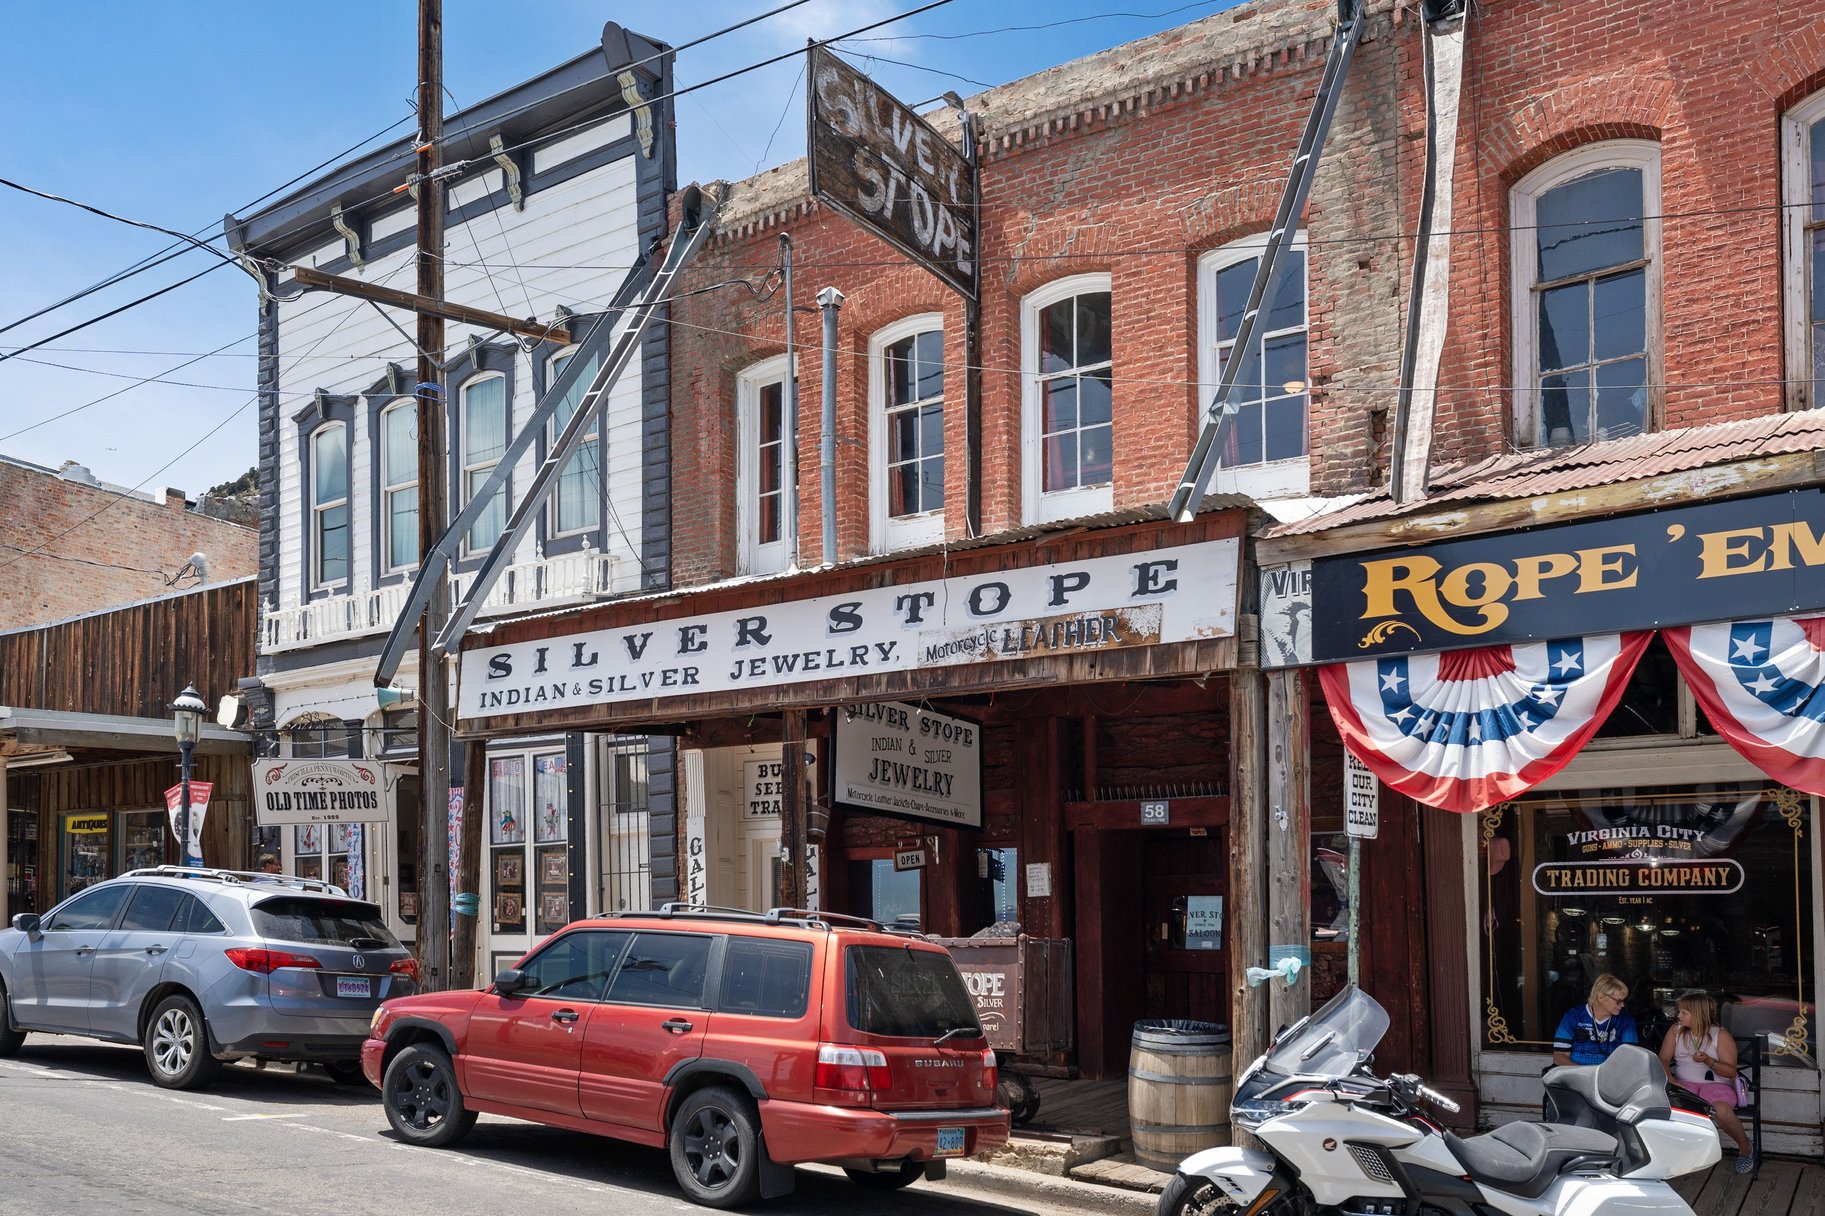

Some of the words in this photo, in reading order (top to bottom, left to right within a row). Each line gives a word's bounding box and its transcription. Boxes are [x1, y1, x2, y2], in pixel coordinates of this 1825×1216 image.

[853, 145, 973, 276] STOPE
[1359, 543, 1639, 636] ROPE
[488, 615, 772, 679] SILVER
[829, 558, 1180, 633] STOPE
[479, 683, 567, 708] INDIAN
[572, 682, 582, 696] &
[588, 665, 700, 695] SILVER
[729, 640, 900, 681] JEWELRY,
[921, 716, 973, 745] STOPE
[871, 737, 902, 752] INDIAN
[908, 738, 917, 756] &
[924, 749, 952, 764] SILVER
[758, 764, 783, 778] BU
[1348, 754, 1372, 772] KE
[868, 757, 954, 796] JEWELRY
[1352, 773, 1373, 790] OUR
[755, 782, 783, 796] SEL
[266, 791, 292, 811] OLD
[293, 791, 328, 811] TIME
[328, 790, 378, 810] PHOTOS
[750, 800, 782, 815] TRA
[1352, 791, 1376, 808] CITY
[1144, 804, 1165, 818] 58
[1348, 809, 1377, 826] CLEAN
[1566, 824, 1651, 846] VIRGINIA
[1656, 824, 1706, 842] CITY
[1581, 844, 1598, 853] GUNS
[1602, 841, 1623, 850] AMMO
[1628, 839, 1664, 848] SUPPLIES
[1668, 840, 1692, 851] SILVER
[901, 854, 921, 866] OPEN
[690, 837, 705, 912] GALL
[1546, 868, 1630, 888] TRADING
[1637, 866, 1731, 887] COMPANY
[1188, 929, 1221, 938] SALOON
[960, 972, 1005, 996] TOPE
[977, 996, 1004, 1008] SILVER
[914, 1060, 964, 1068] SUBARU
